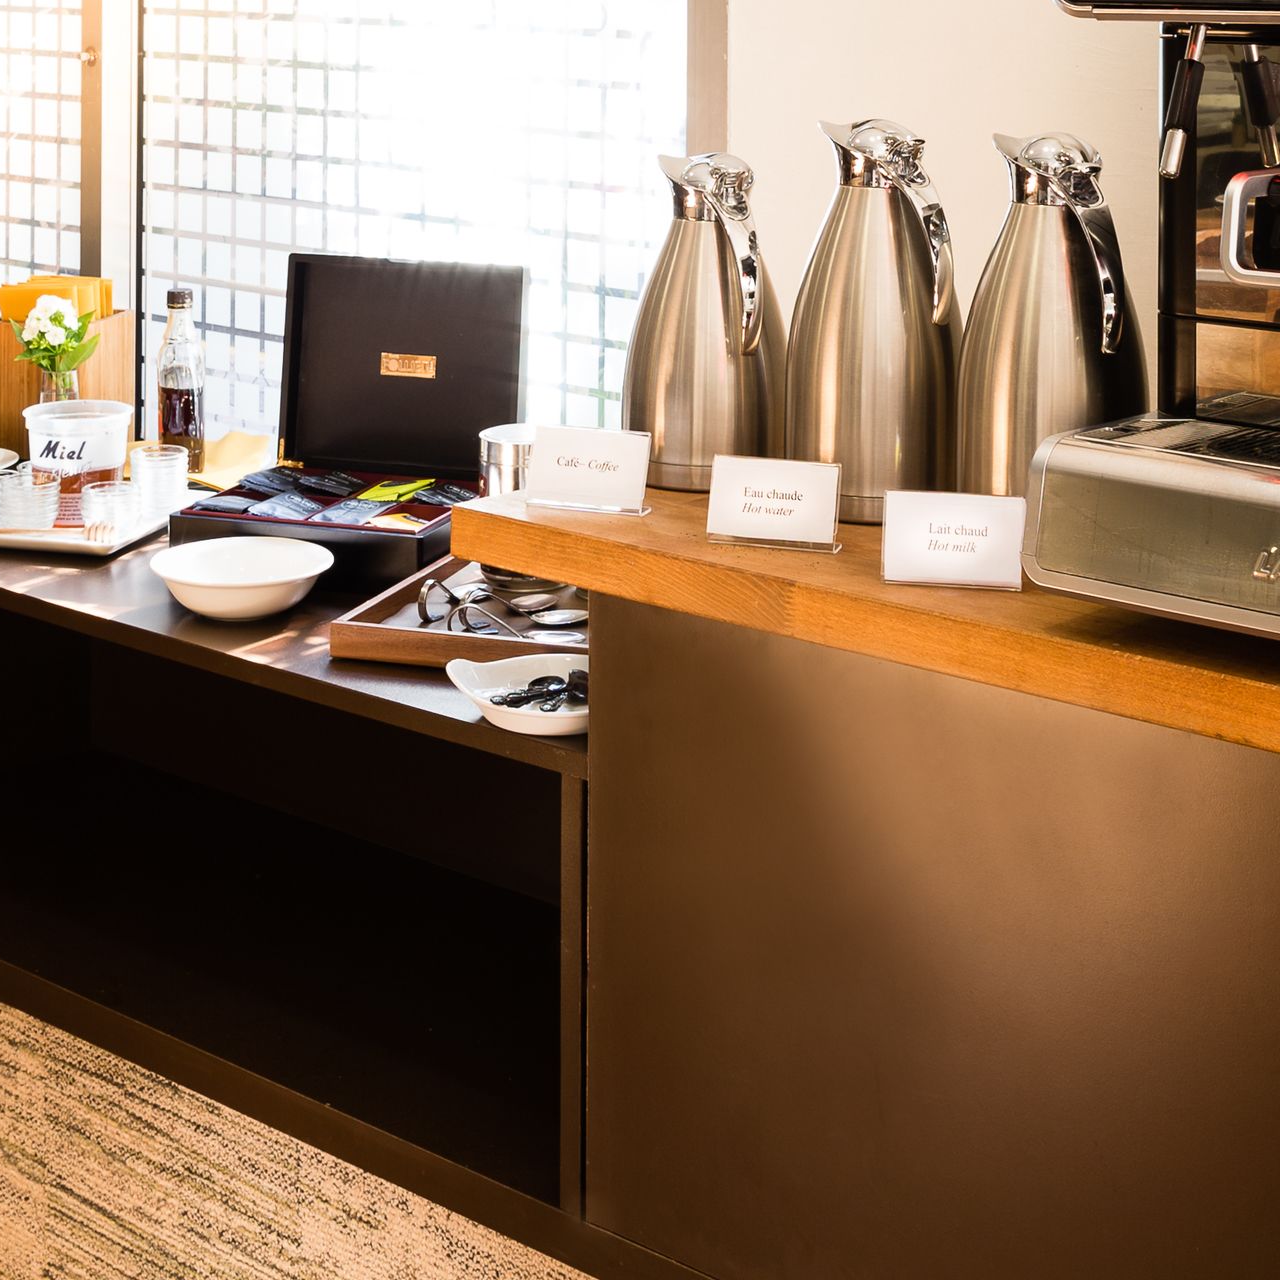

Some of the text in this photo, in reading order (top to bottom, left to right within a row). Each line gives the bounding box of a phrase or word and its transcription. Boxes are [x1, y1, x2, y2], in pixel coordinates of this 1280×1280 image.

[39, 440, 86, 460] Miel
[588, 459, 619, 472] Coffee
[744, 486, 803, 501] Eau chaude
[742, 502, 795, 516] Hot water
[929, 522, 988, 537] Lait chaud
[927, 539, 977, 553] Hot milk
